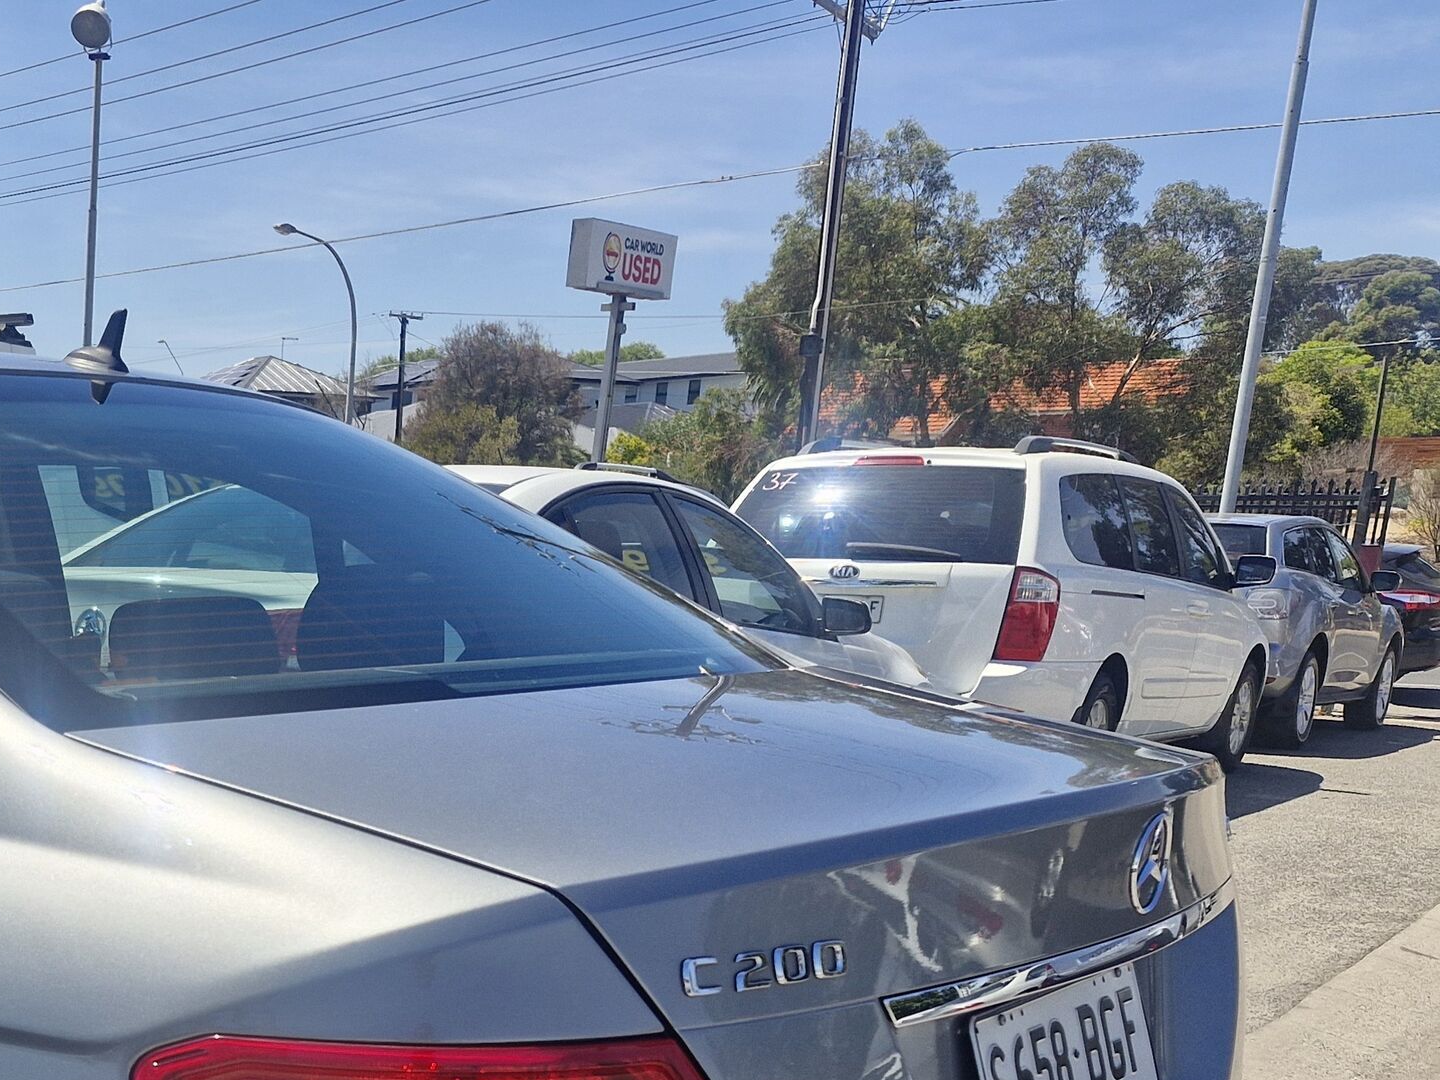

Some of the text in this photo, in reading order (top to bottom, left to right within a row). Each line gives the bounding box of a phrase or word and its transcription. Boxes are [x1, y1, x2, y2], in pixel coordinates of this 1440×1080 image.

[624, 237, 664, 256] CAR WORLD
[622, 253, 661, 285] USED
[762, 472, 799, 490] 37
[831, 566, 857, 578] KIA
[681, 939, 847, 997] C 200
